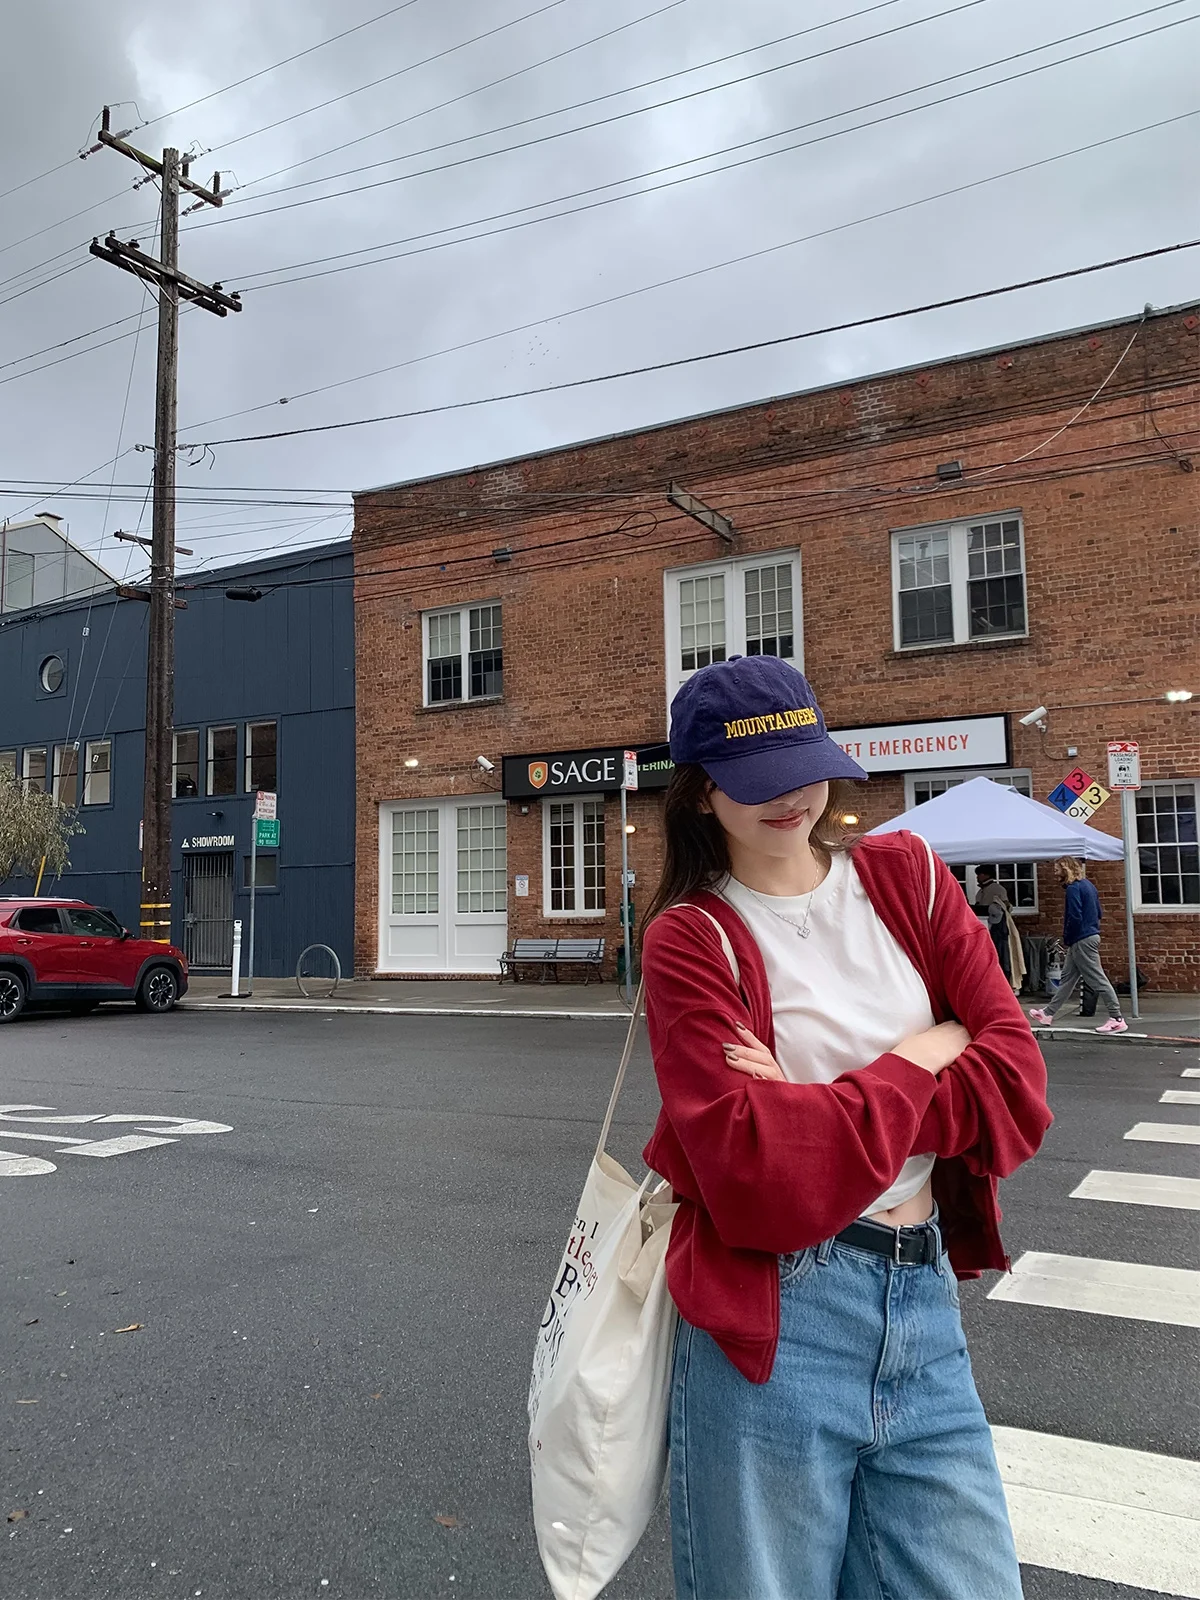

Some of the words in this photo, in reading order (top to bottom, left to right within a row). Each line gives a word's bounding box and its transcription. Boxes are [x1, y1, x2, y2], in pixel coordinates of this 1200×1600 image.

[869, 734, 969, 757] EMERGENCY
[550, 757, 616, 785] SAGE
[637, 760, 675, 772] TERINA
[1072, 772, 1084, 791] 3
[1054, 787, 1068, 806] 4
[1089, 787, 1102, 805] 3
[1069, 806, 1089, 818] OX
[191, 835, 235, 848] SHOWROOM
